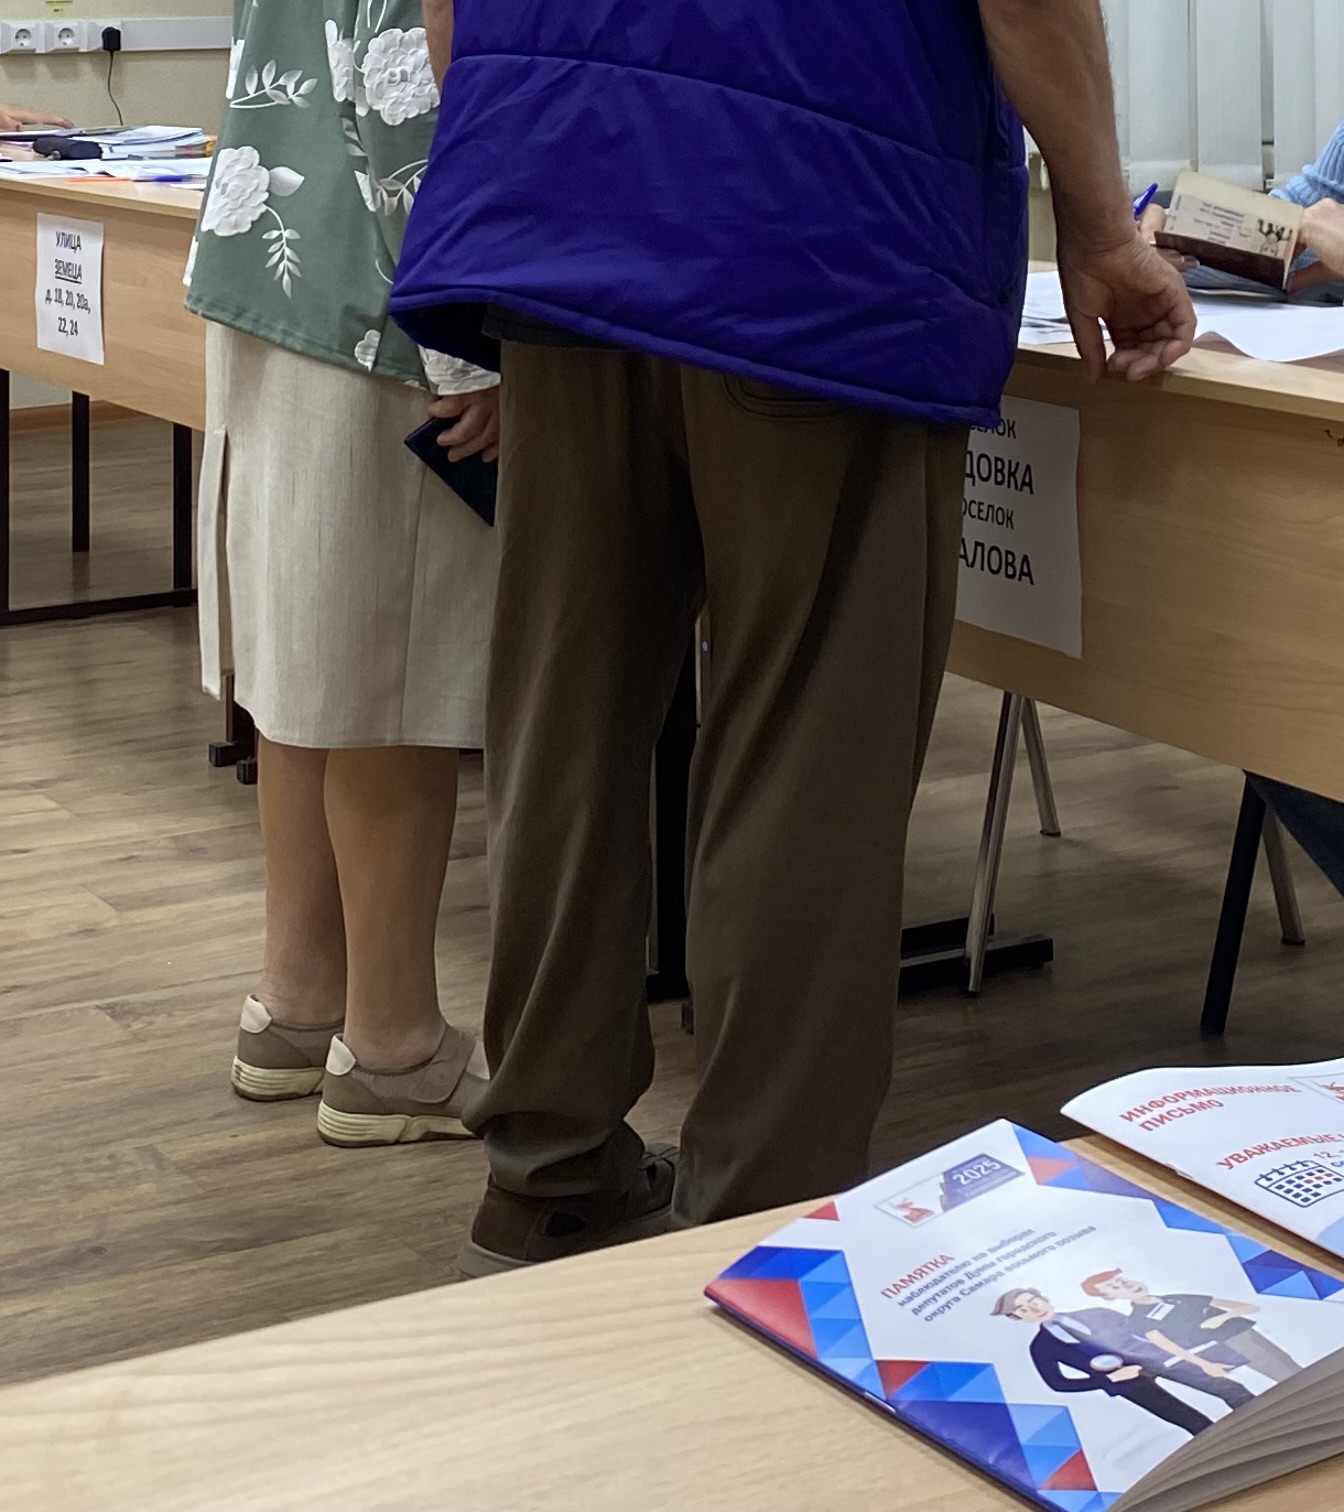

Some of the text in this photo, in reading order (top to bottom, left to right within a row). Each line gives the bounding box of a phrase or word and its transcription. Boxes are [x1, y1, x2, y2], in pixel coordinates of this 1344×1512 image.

[55, 231, 82, 254] УЛИЦА
[1119, 1085, 1302, 1122] ИНФОРМАЦИОННОЕ
[1139, 1099, 1224, 1132] ПИСЬМО
[1216, 1132, 1341, 1170] УВАЖАЕМЫЕ
[952, 1159, 1001, 1185] 2025
[880, 1254, 955, 1299] ПАМЯТКА
[911, 1277, 965, 1316] депутатов
